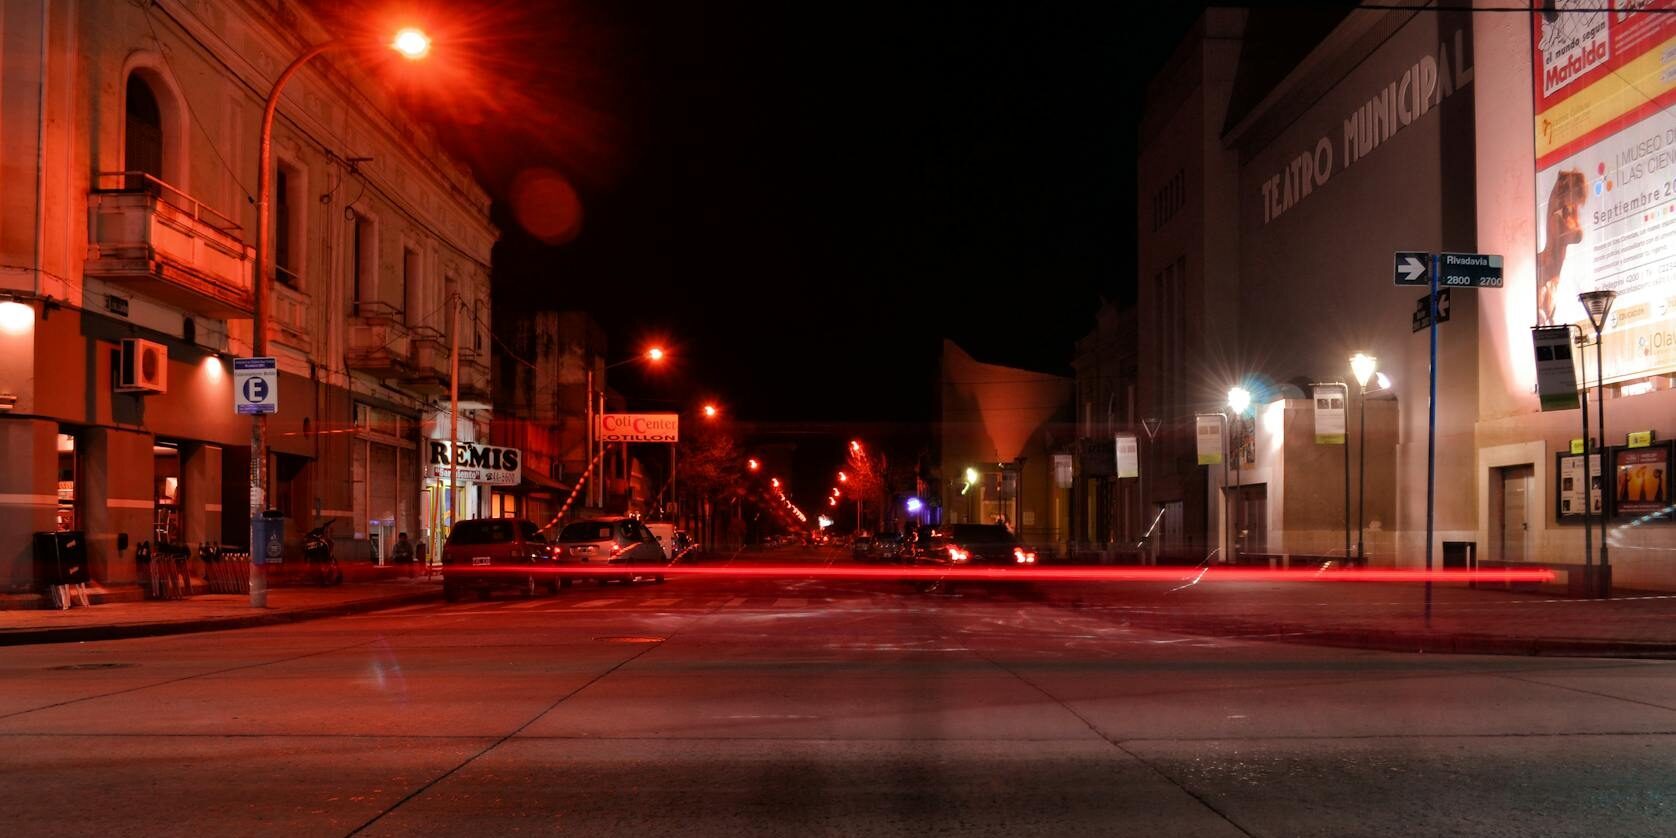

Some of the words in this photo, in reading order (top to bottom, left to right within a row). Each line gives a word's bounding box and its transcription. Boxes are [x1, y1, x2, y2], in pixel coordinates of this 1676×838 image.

[1555, 37, 1580, 59] mundo
[1545, 40, 1607, 91] Mafalda
[1262, 136, 1333, 225] TEATRO
[1343, 28, 1474, 169] MUNICIPAL
[1621, 134, 1661, 166] MUSEO
[1622, 163, 1643, 186] LAS
[1593, 188, 1660, 225] Septiembre
[1446, 255, 1488, 266] Rivadavia
[1447, 275, 1471, 285] 2800
[1480, 276, 1503, 286] 2700
[248, 378, 263, 402] E
[602, 415, 632, 432] Coti
[633, 418, 677, 434] Center
[430, 441, 518, 471] REMIS
